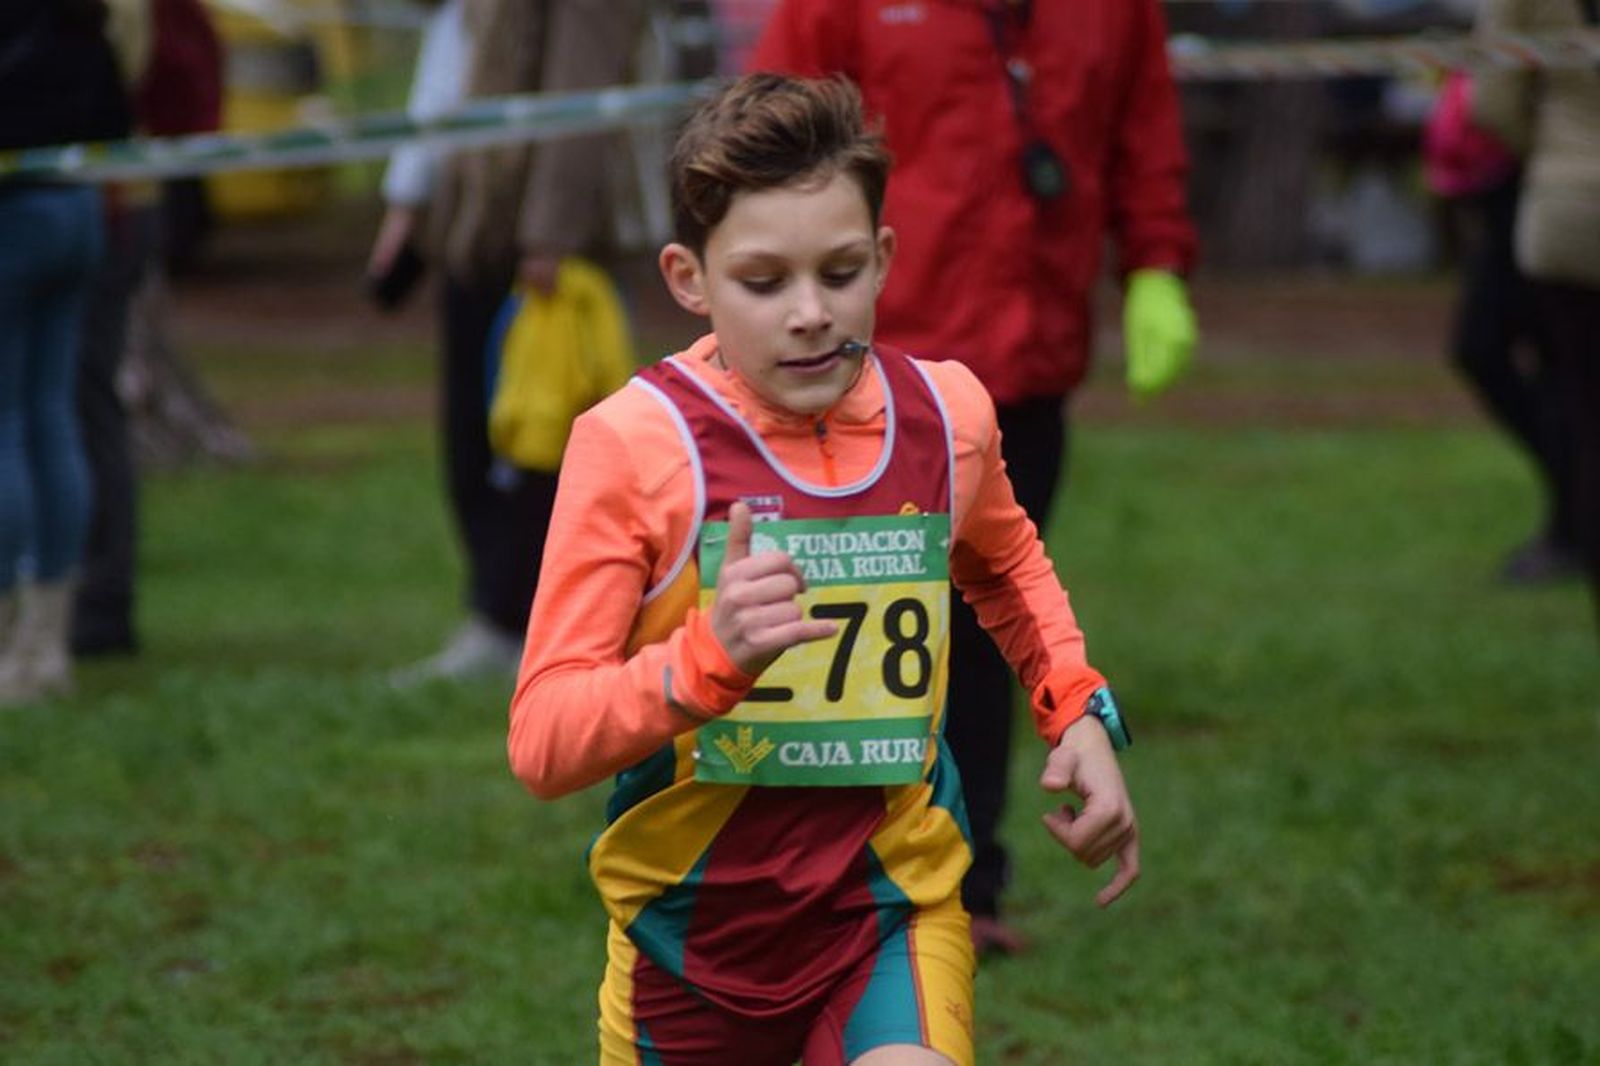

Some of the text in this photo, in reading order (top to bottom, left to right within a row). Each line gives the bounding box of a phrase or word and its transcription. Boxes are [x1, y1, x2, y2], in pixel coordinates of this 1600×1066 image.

[786, 529, 926, 556] FUNDACION
[852, 554, 928, 577] RURAL
[746, 597, 932, 702] 78
[778, 741, 854, 768] CAJA
